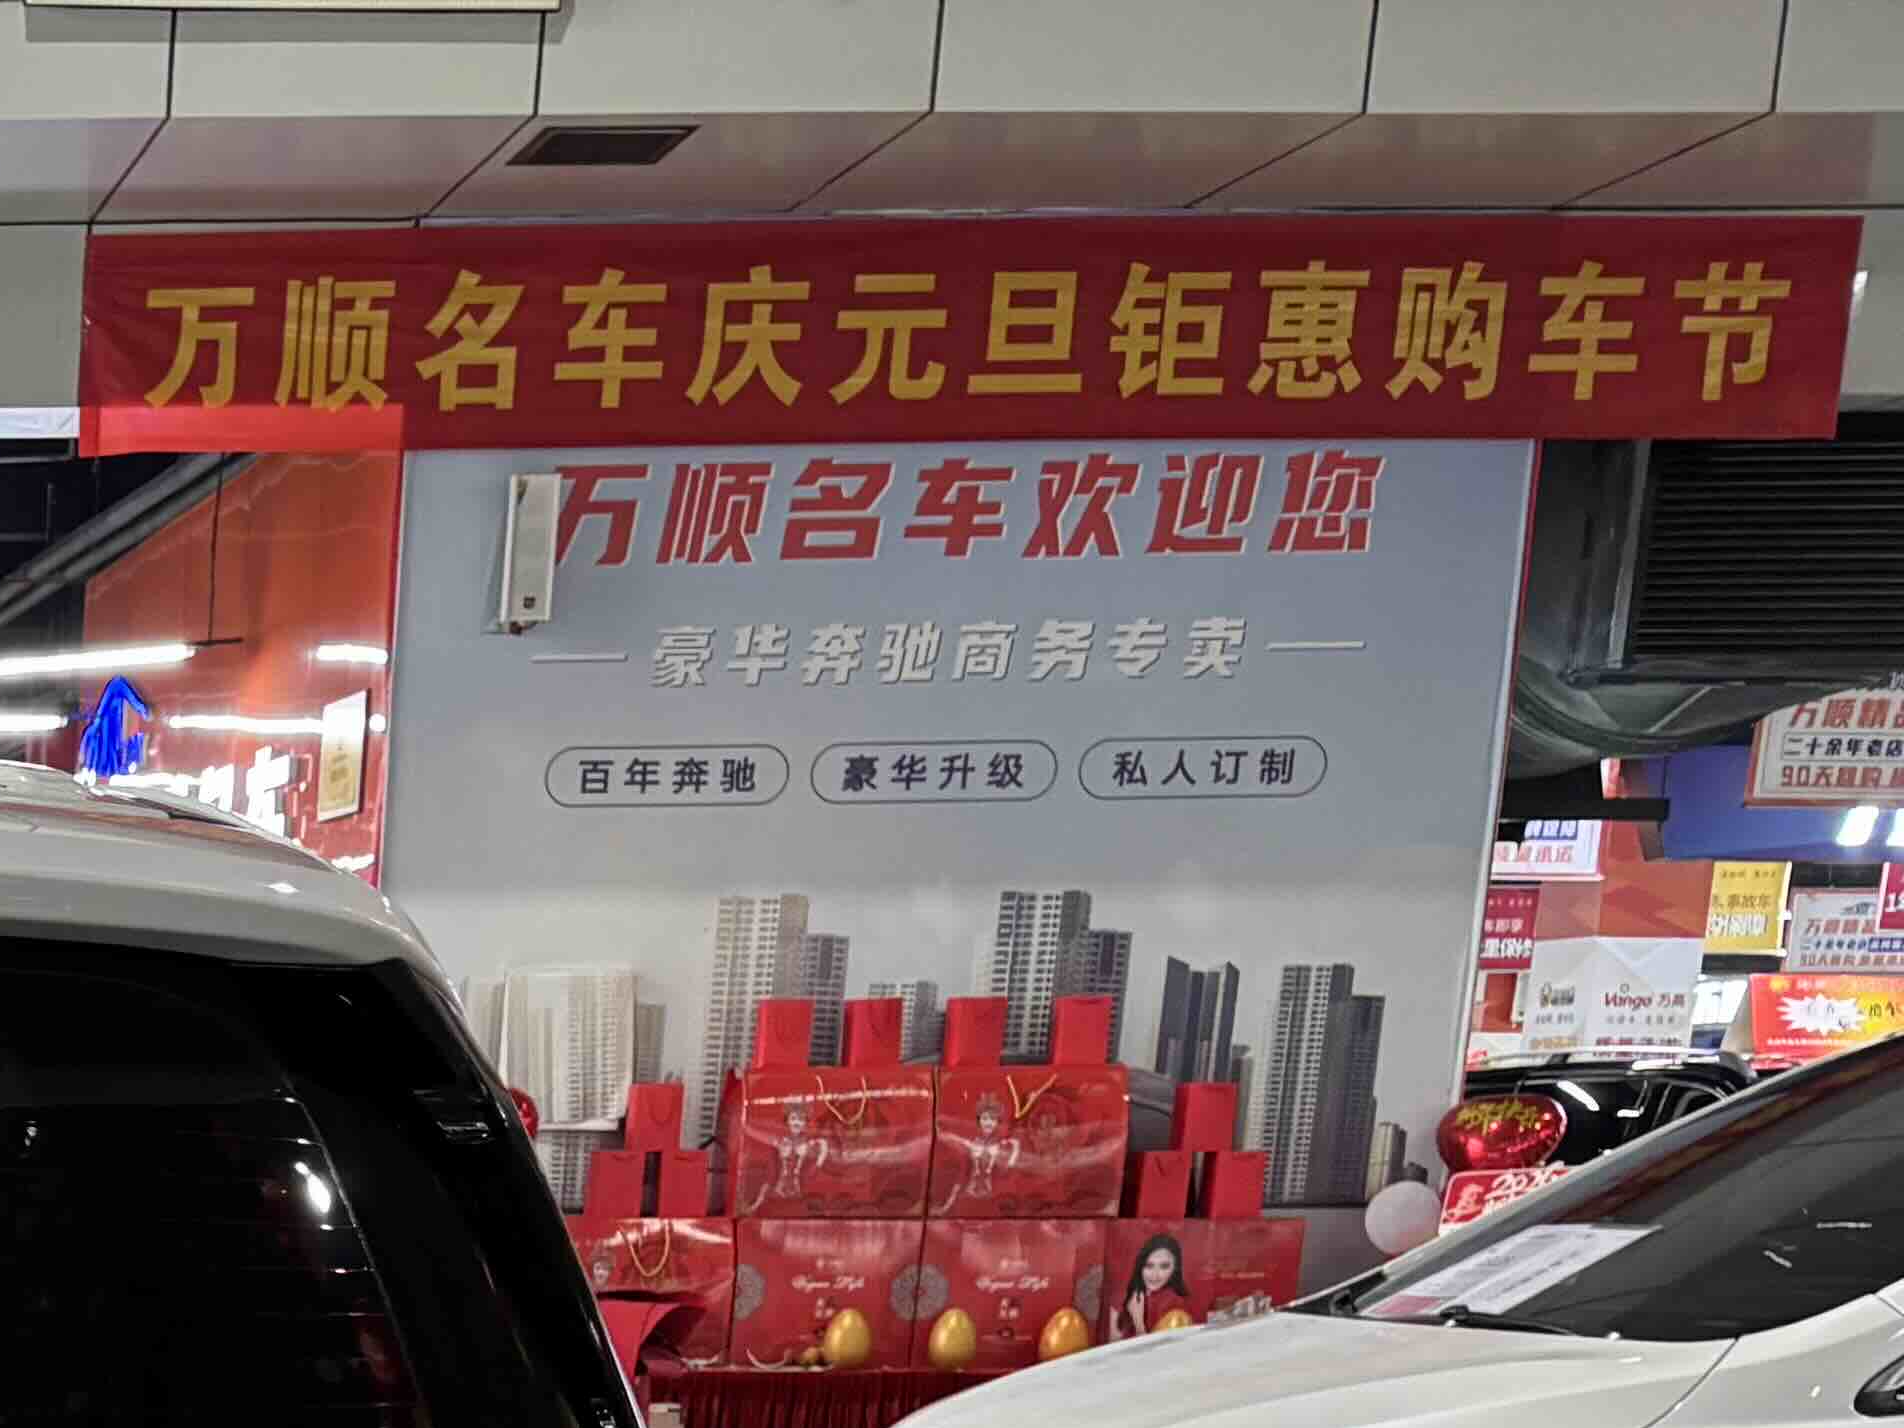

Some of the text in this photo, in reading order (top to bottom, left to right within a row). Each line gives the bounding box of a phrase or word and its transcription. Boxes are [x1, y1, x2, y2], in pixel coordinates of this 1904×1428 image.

[142, 265, 1798, 410] 万顺名车庆元旦钜惠购车节
[554, 450, 1385, 566] 万顺名车欢迎您
[648, 617, 1250, 689] 豪华奔驰商务专卖
[578, 746, 1297, 795] 百年奔驰 豪华升级 私人订制
